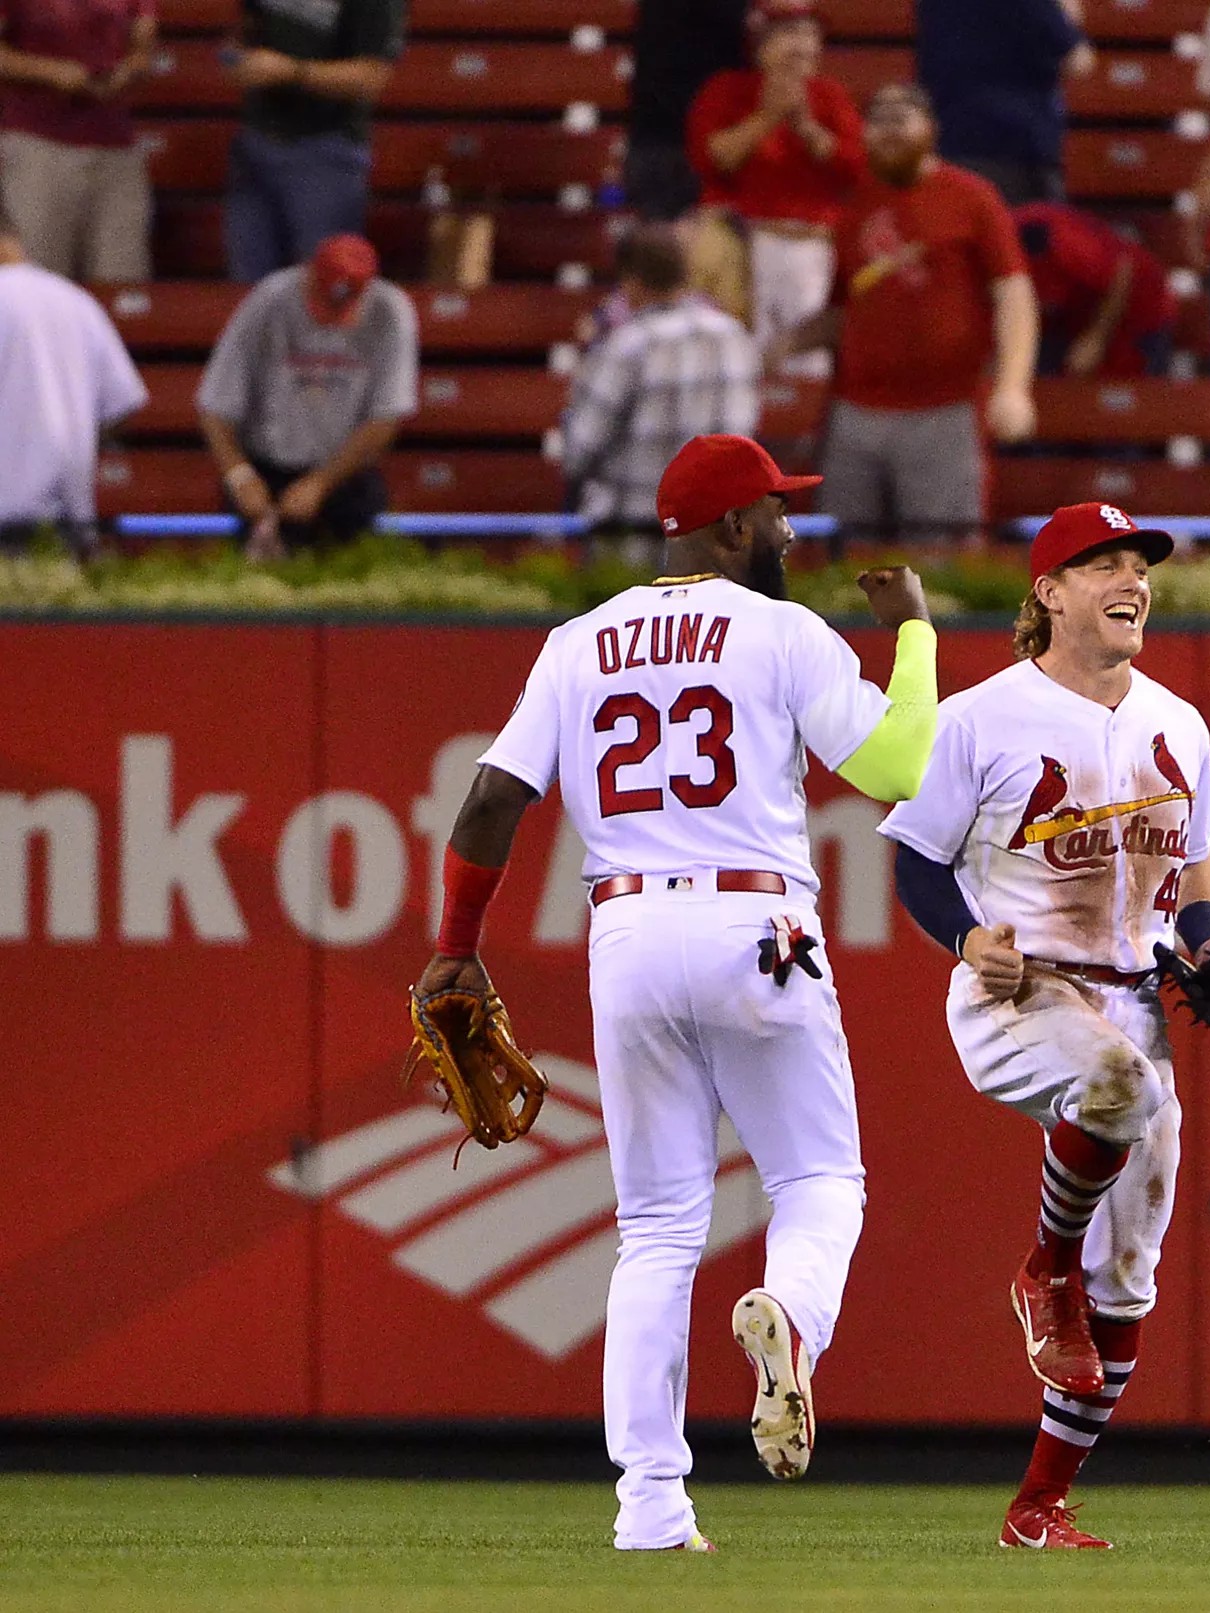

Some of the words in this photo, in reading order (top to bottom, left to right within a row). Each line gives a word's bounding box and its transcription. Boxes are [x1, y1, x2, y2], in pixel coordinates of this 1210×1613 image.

[596, 613, 731, 675] OZUNA
[593, 685, 737, 818] 23
[1044, 806, 1188, 871] Cardinal
[1153, 867, 1181, 924] 4
